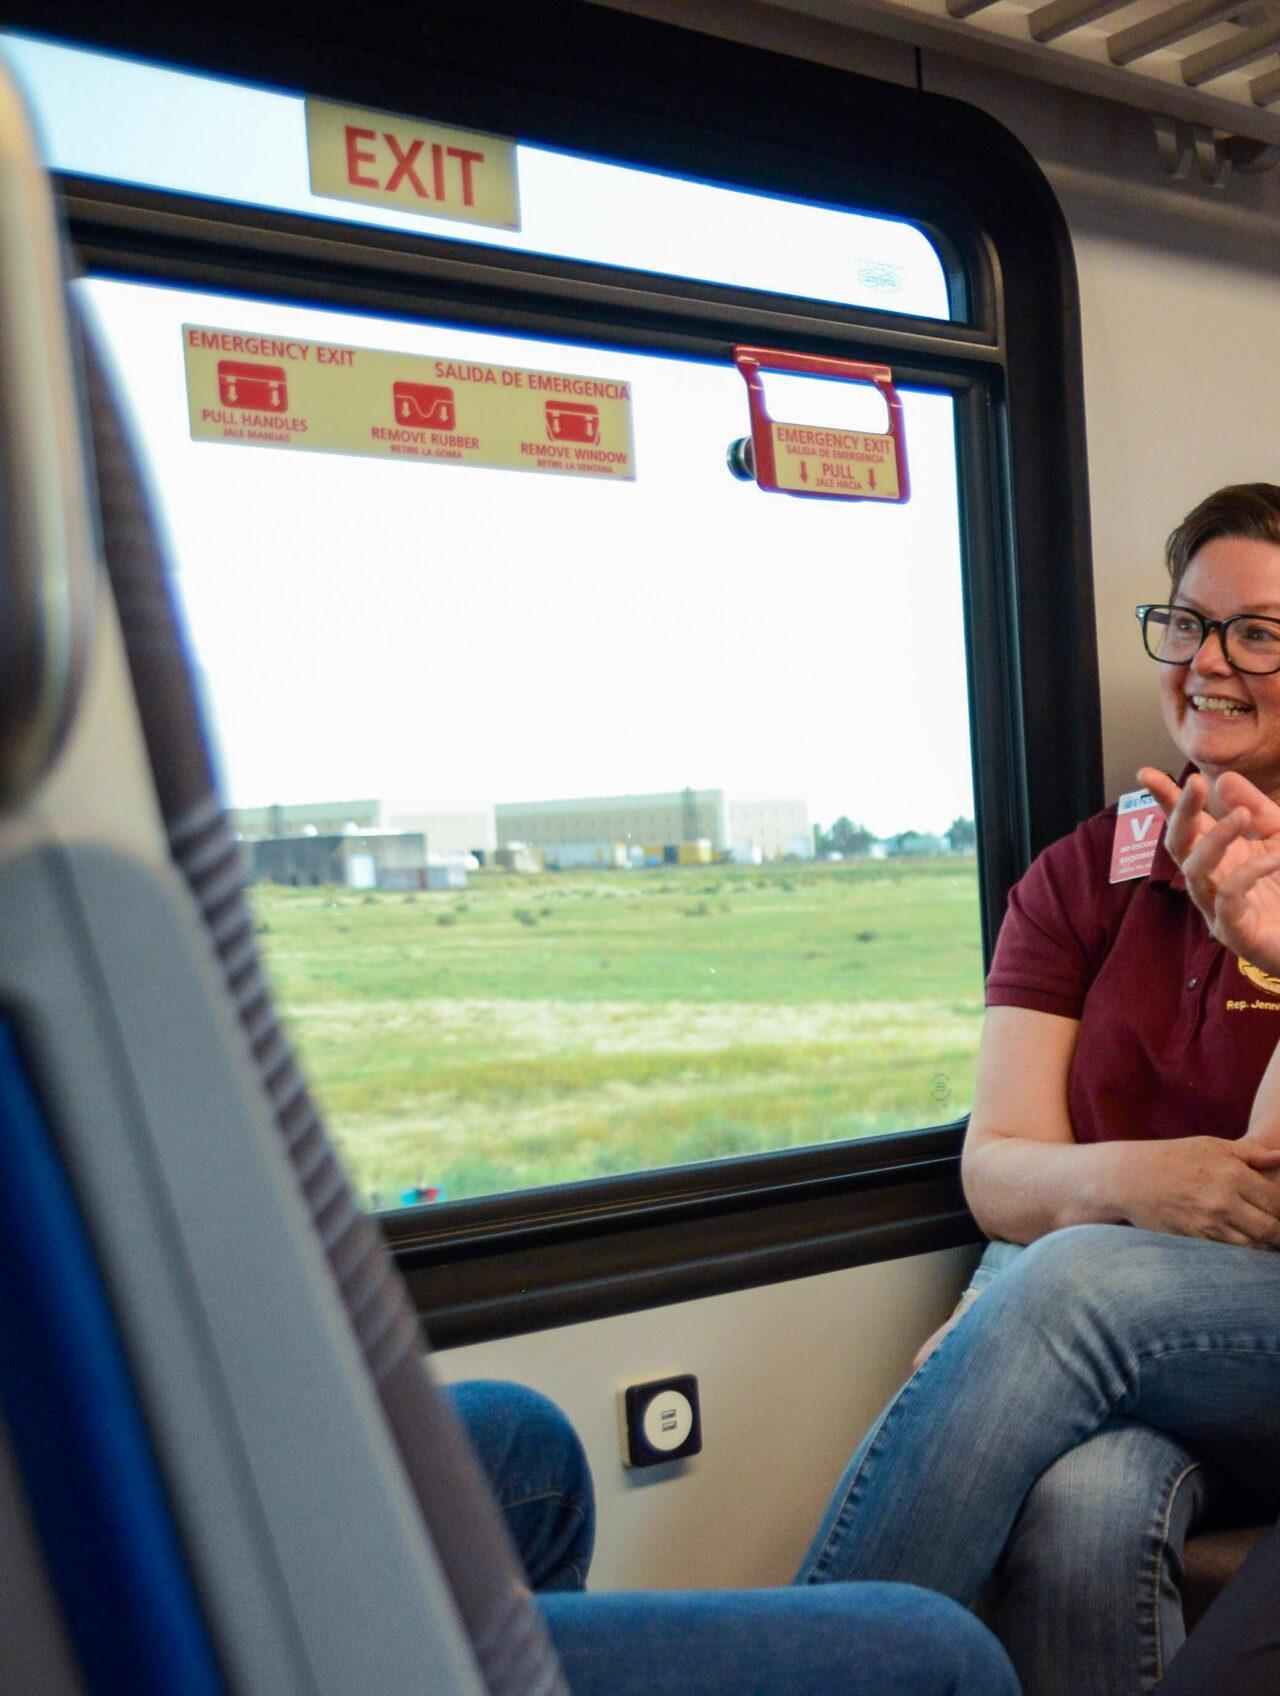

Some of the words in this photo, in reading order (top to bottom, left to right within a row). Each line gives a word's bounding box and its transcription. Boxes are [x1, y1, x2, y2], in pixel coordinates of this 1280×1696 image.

[345, 125, 485, 206] EXIT
[189, 329, 309, 361] EMERGENCY
[316, 347, 356, 367] EXIT
[435, 362, 496, 384] SALIDA
[502, 371, 523, 387] DE
[528, 374, 630, 400] EMERGENCIA
[202, 409, 237, 425] PULL
[242, 414, 308, 432] HANDLES
[223, 428, 245, 438] JALE
[372, 427, 427, 444] REMOVE
[431, 433, 479, 449] RUBBER
[777, 427, 859, 449] EMERGENCY
[864, 438, 891, 454] EXIT
[390, 444, 419, 455] RETIRE
[422, 447, 433, 456] LA
[435, 448, 463, 459] GOMA
[521, 443, 571, 459] REMOVE
[575, 448, 628, 464] WINDOW
[786, 445, 817, 456] SALIDA
[819, 449, 831, 458] DE
[832, 450, 885, 464] EMERGENCIA
[537, 459, 562, 470] RETIRE
[565, 461, 576, 470] LA
[577, 463, 614, 473] VENTANA
[822, 463, 855, 479] PULL
[816, 478, 834, 488] JALE
[1131, 814, 1155, 842] V
[1226, 1000, 1249, 1011] Rep.
